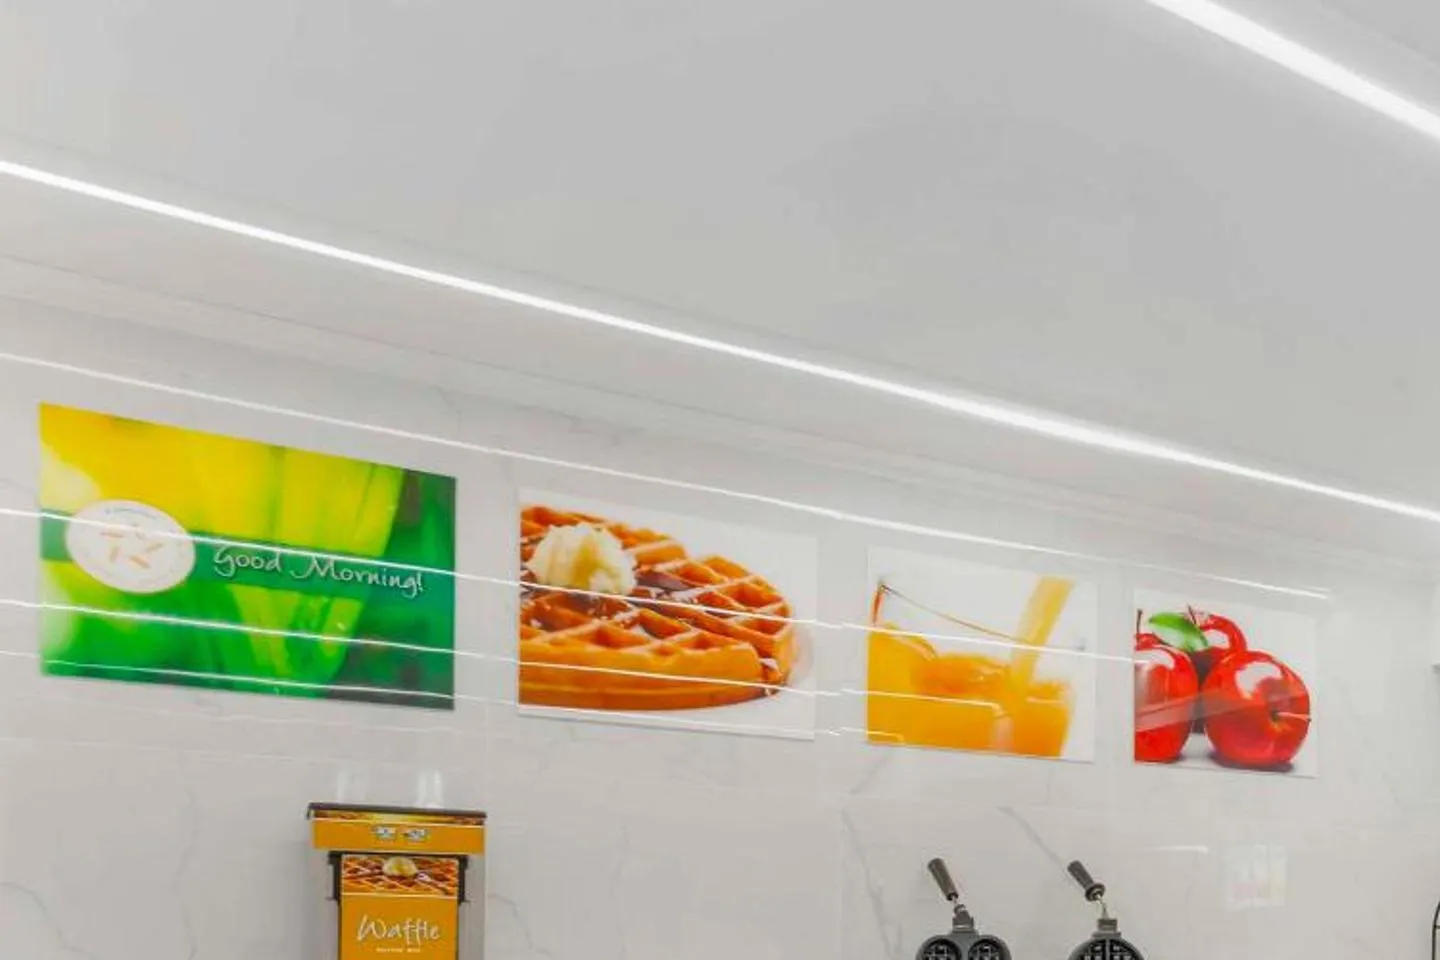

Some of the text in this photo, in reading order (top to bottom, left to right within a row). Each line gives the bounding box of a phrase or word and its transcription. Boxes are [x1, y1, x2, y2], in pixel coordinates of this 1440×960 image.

[214, 545, 424, 598] Good Morning!
[357, 914, 439, 945] Waffle
